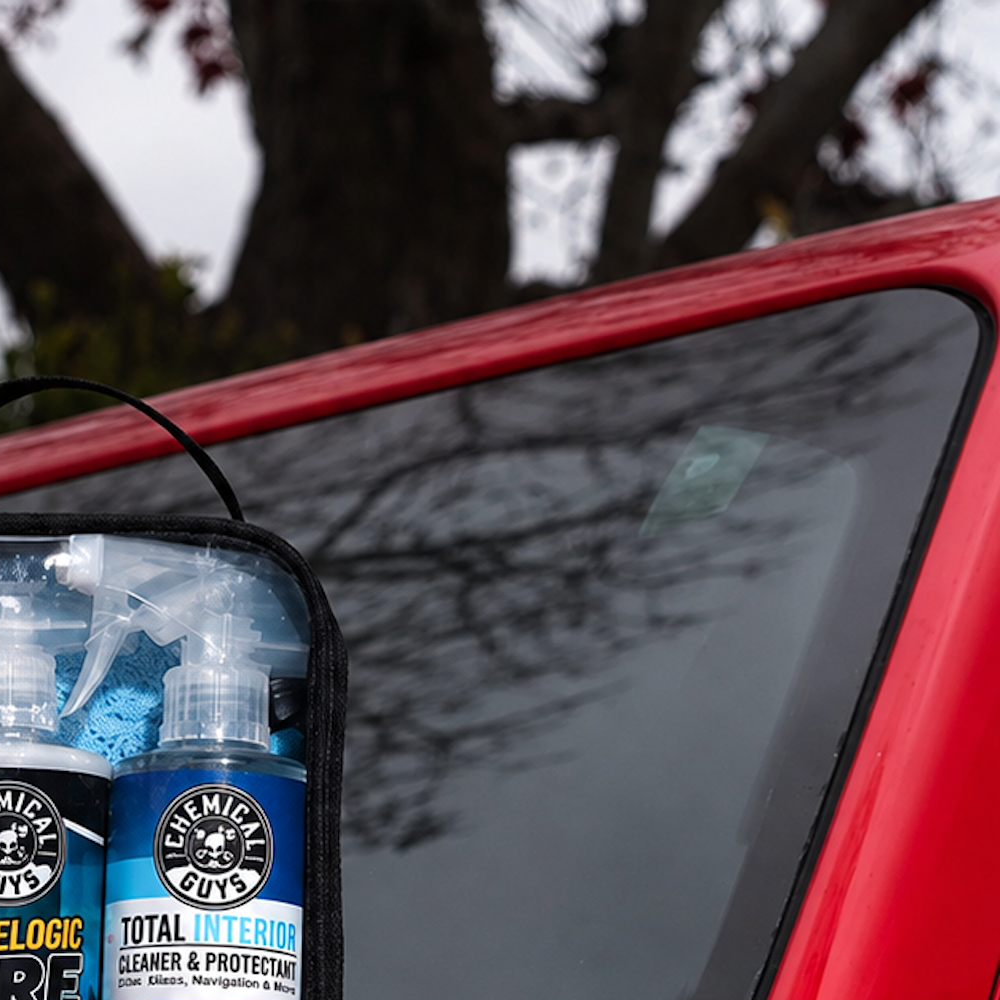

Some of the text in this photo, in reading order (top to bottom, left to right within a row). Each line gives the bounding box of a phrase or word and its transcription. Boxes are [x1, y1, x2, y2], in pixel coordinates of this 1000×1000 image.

[164, 793, 265, 851] CHEMICAL
[180, 872, 247, 899] GUYS
[121, 914, 296, 952] TOTAL INTERIOR
[119, 952, 182, 975] CLEANER
[187, 951, 200, 972] &
[192, 975, 260, 990] Navigation
